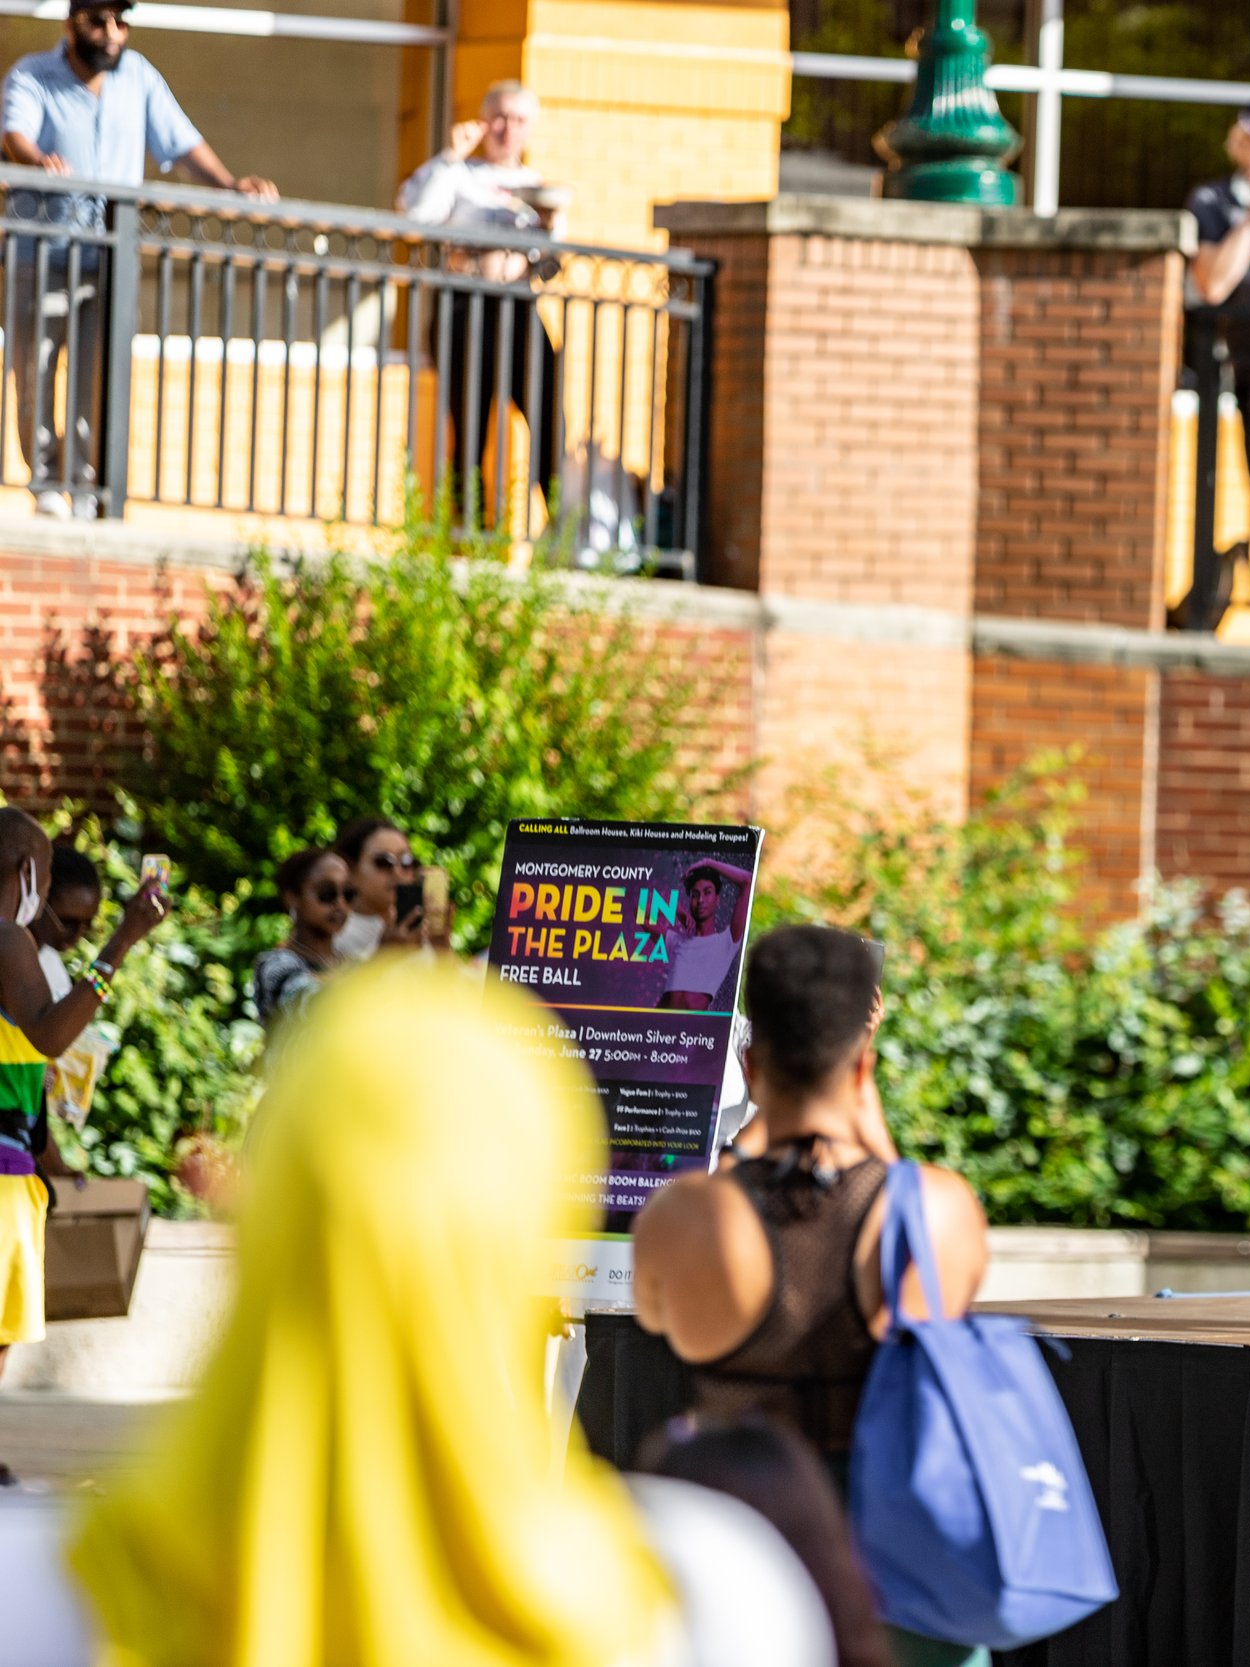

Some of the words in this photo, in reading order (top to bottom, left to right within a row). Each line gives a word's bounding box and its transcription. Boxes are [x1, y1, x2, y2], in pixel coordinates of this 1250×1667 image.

[519, 823, 552, 833] CALLING
[553, 824, 568, 834] ALL
[570, 825, 600, 835] Ballroom
[602, 827, 628, 837] Houses,
[630, 828, 643, 838] Kiki
[644, 829, 669, 839] Houses
[670, 830, 684, 839] and
[685, 830, 717, 843] Modeling
[719, 831, 748, 843] Troupes!
[515, 862, 600, 878] MONTGOMERY
[602, 865, 653, 880] COUNTY
[508, 882, 626, 924] PRIDE
[636, 888, 679, 926] IN
[507, 926, 566, 959] THE
[572, 929, 669, 964] PLAZA
[499, 964, 540, 984] FREE
[542, 966, 581, 987] BALL
[547, 1024, 577, 1039] Plaza
[586, 1026, 643, 1042] Downtown
[646, 1029, 677, 1045] Silver
[679, 1031, 715, 1050] Spring
[560, 1044, 586, 1059] June
[588, 1048, 602, 1061] 27
[604, 1048, 641, 1062] 5:00PM
[650, 1050, 688, 1064] 8:00PM
[608, 1175, 636, 1186] BOOM
[599, 1193, 615, 1205] THE
[616, 1195, 646, 1206] BEATS!
